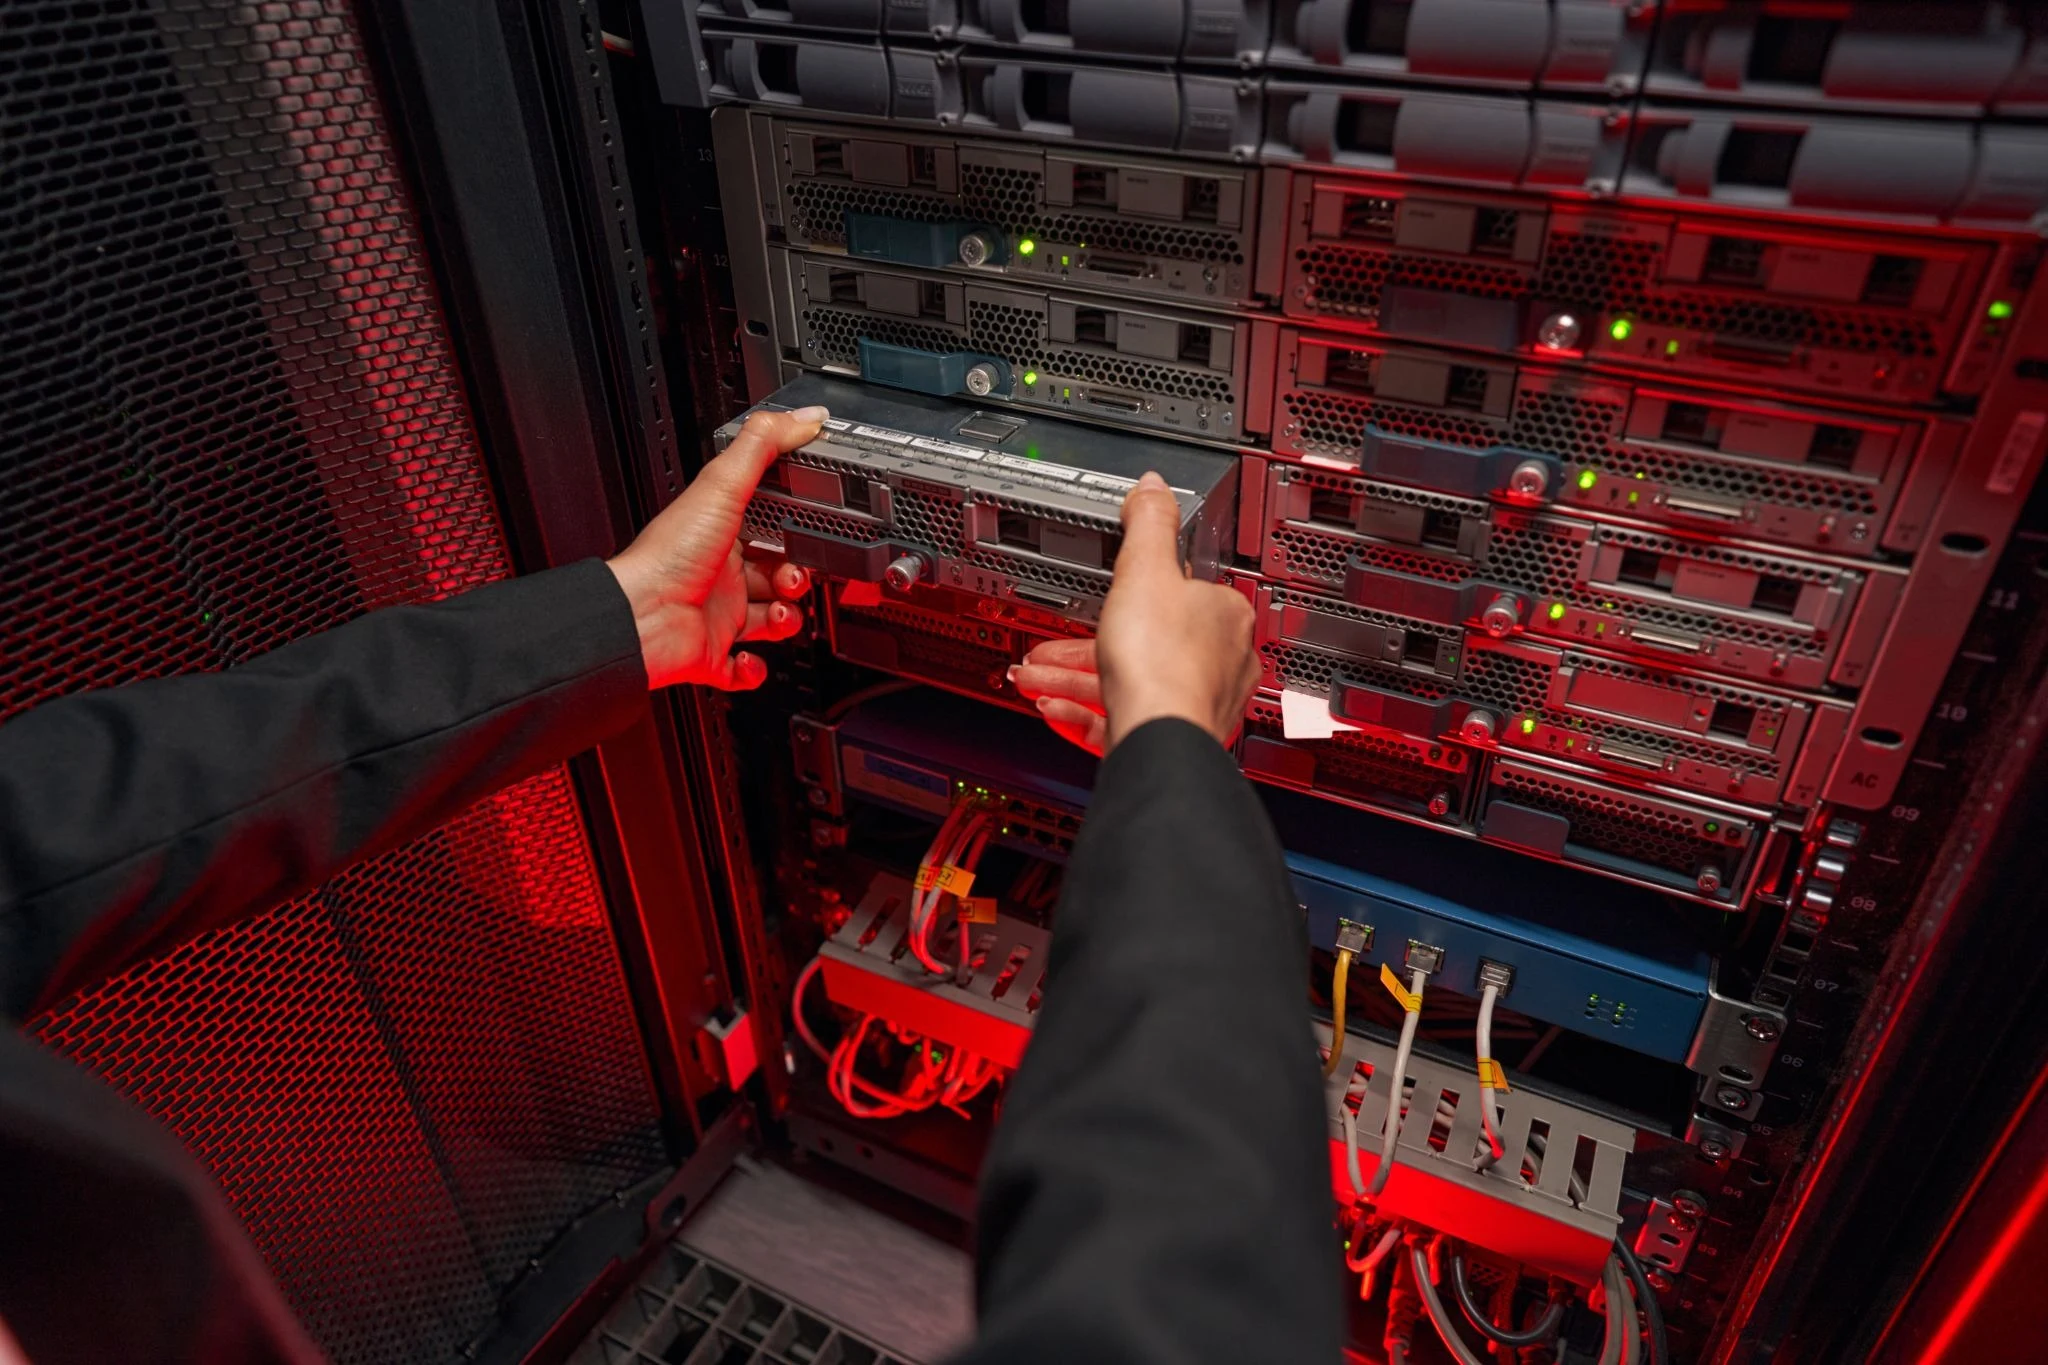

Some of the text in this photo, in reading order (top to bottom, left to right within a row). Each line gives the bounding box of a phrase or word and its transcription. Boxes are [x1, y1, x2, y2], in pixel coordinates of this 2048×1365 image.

[698, 148, 713, 162] 13
[713, 252, 729, 267] 12
[1987, 587, 2020, 610] 11
[1936, 702, 1968, 723] 10
[1850, 772, 1879, 789] AC
[1890, 805, 1920, 822] 09
[1850, 896, 1877, 911] 08
[1814, 979, 1839, 992] 07
[1781, 1054, 1804, 1068] 06
[1751, 1123, 1774, 1136] 05
